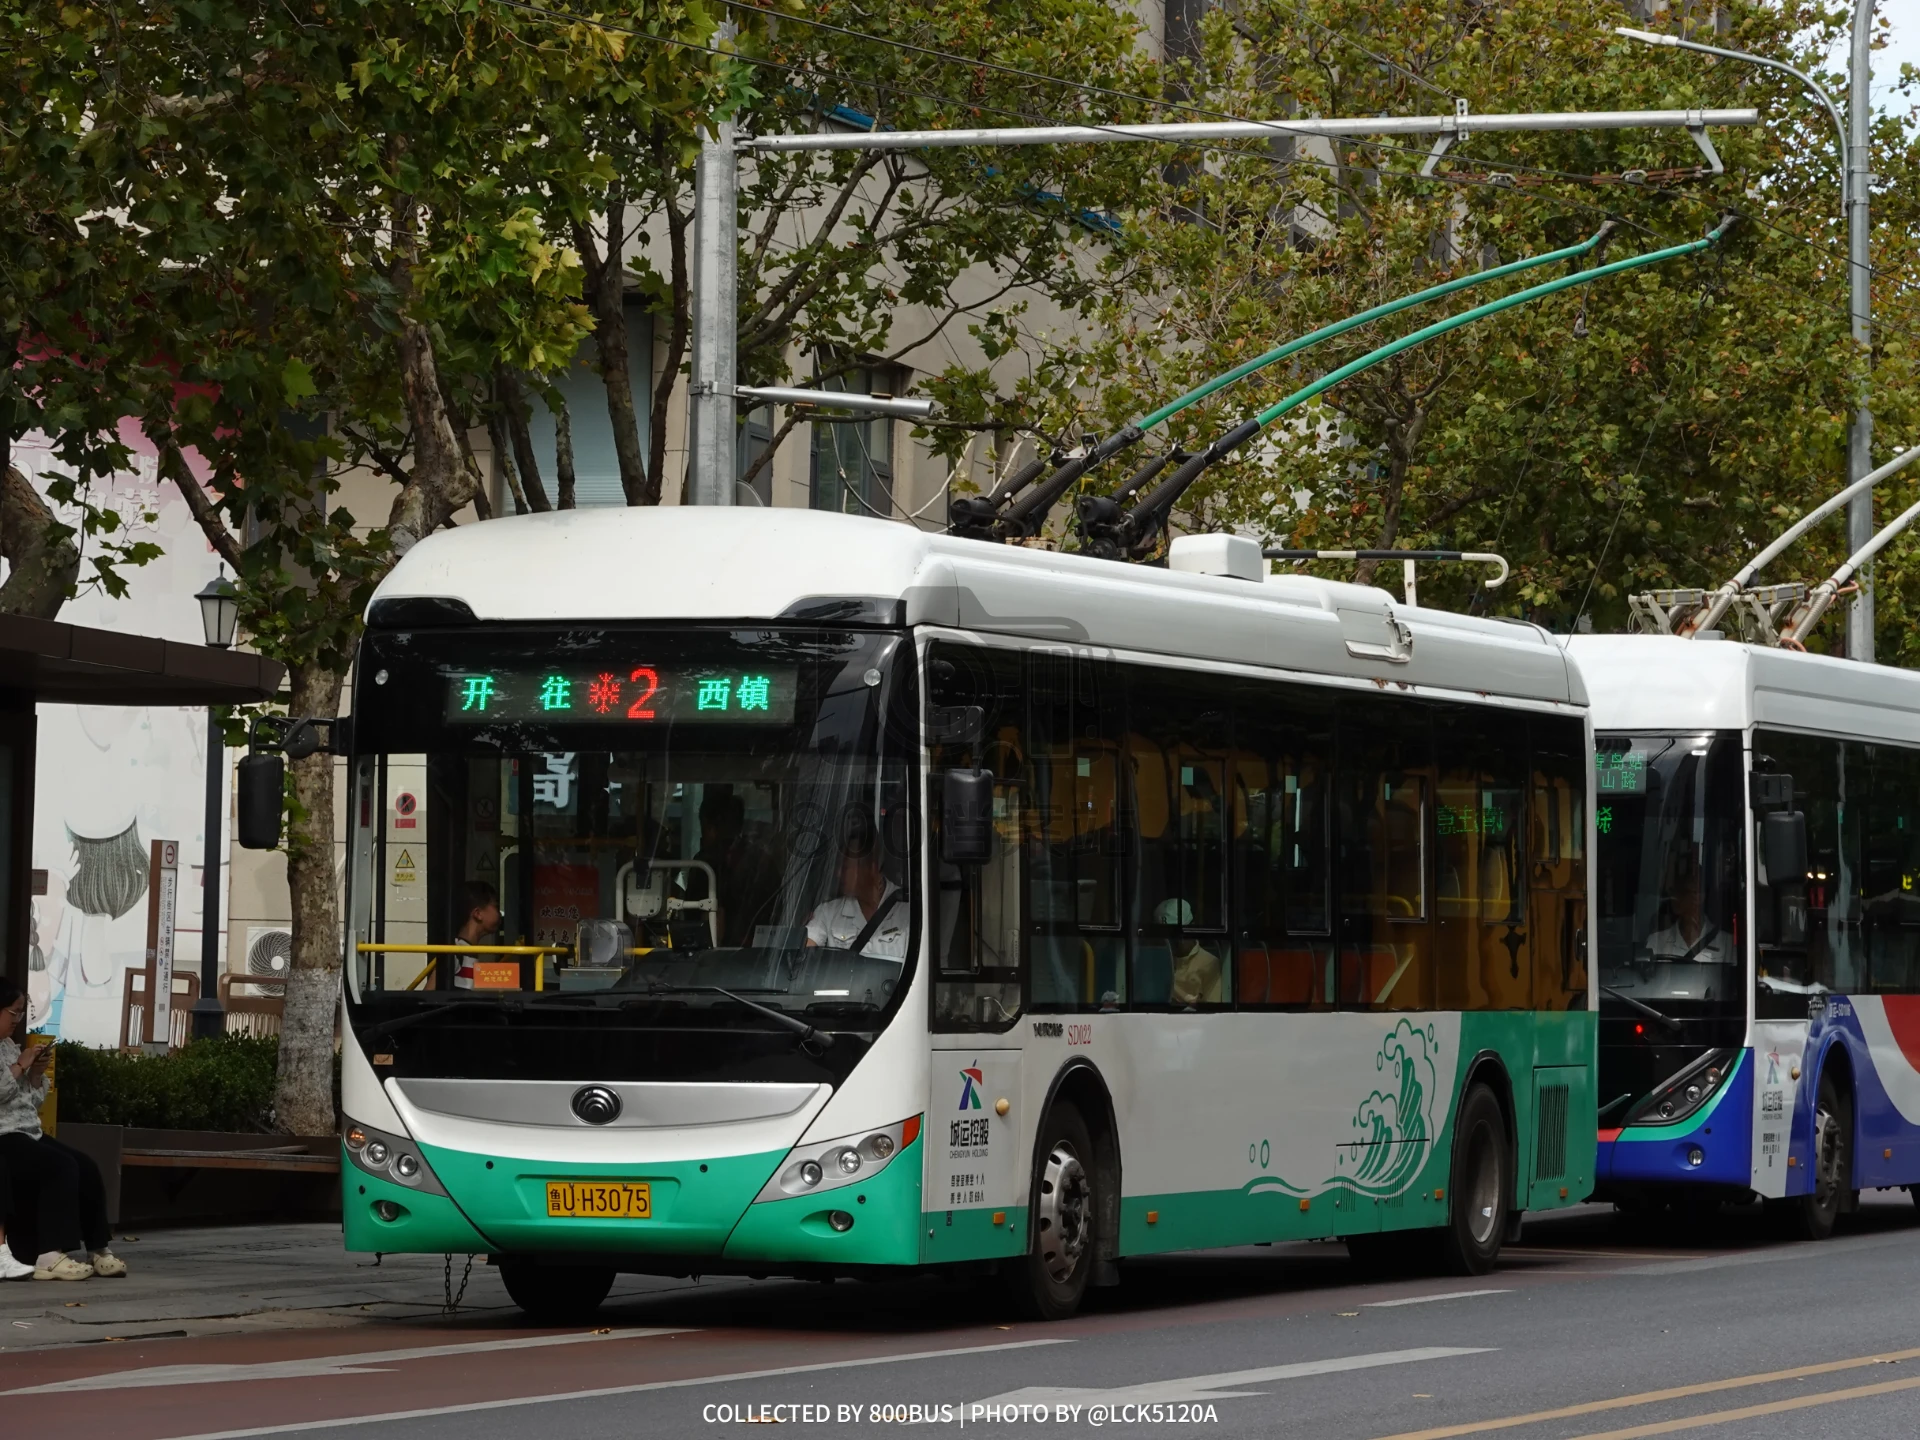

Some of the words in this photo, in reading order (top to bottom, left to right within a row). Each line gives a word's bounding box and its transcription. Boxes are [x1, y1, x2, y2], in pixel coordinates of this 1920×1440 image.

[462, 676, 571, 710] 开往
[627, 669, 658, 719] 2
[698, 676, 770, 711] 西镇
[540, 905, 580, 920] 欢迎您
[949, 1118, 989, 1148] 城运控股
